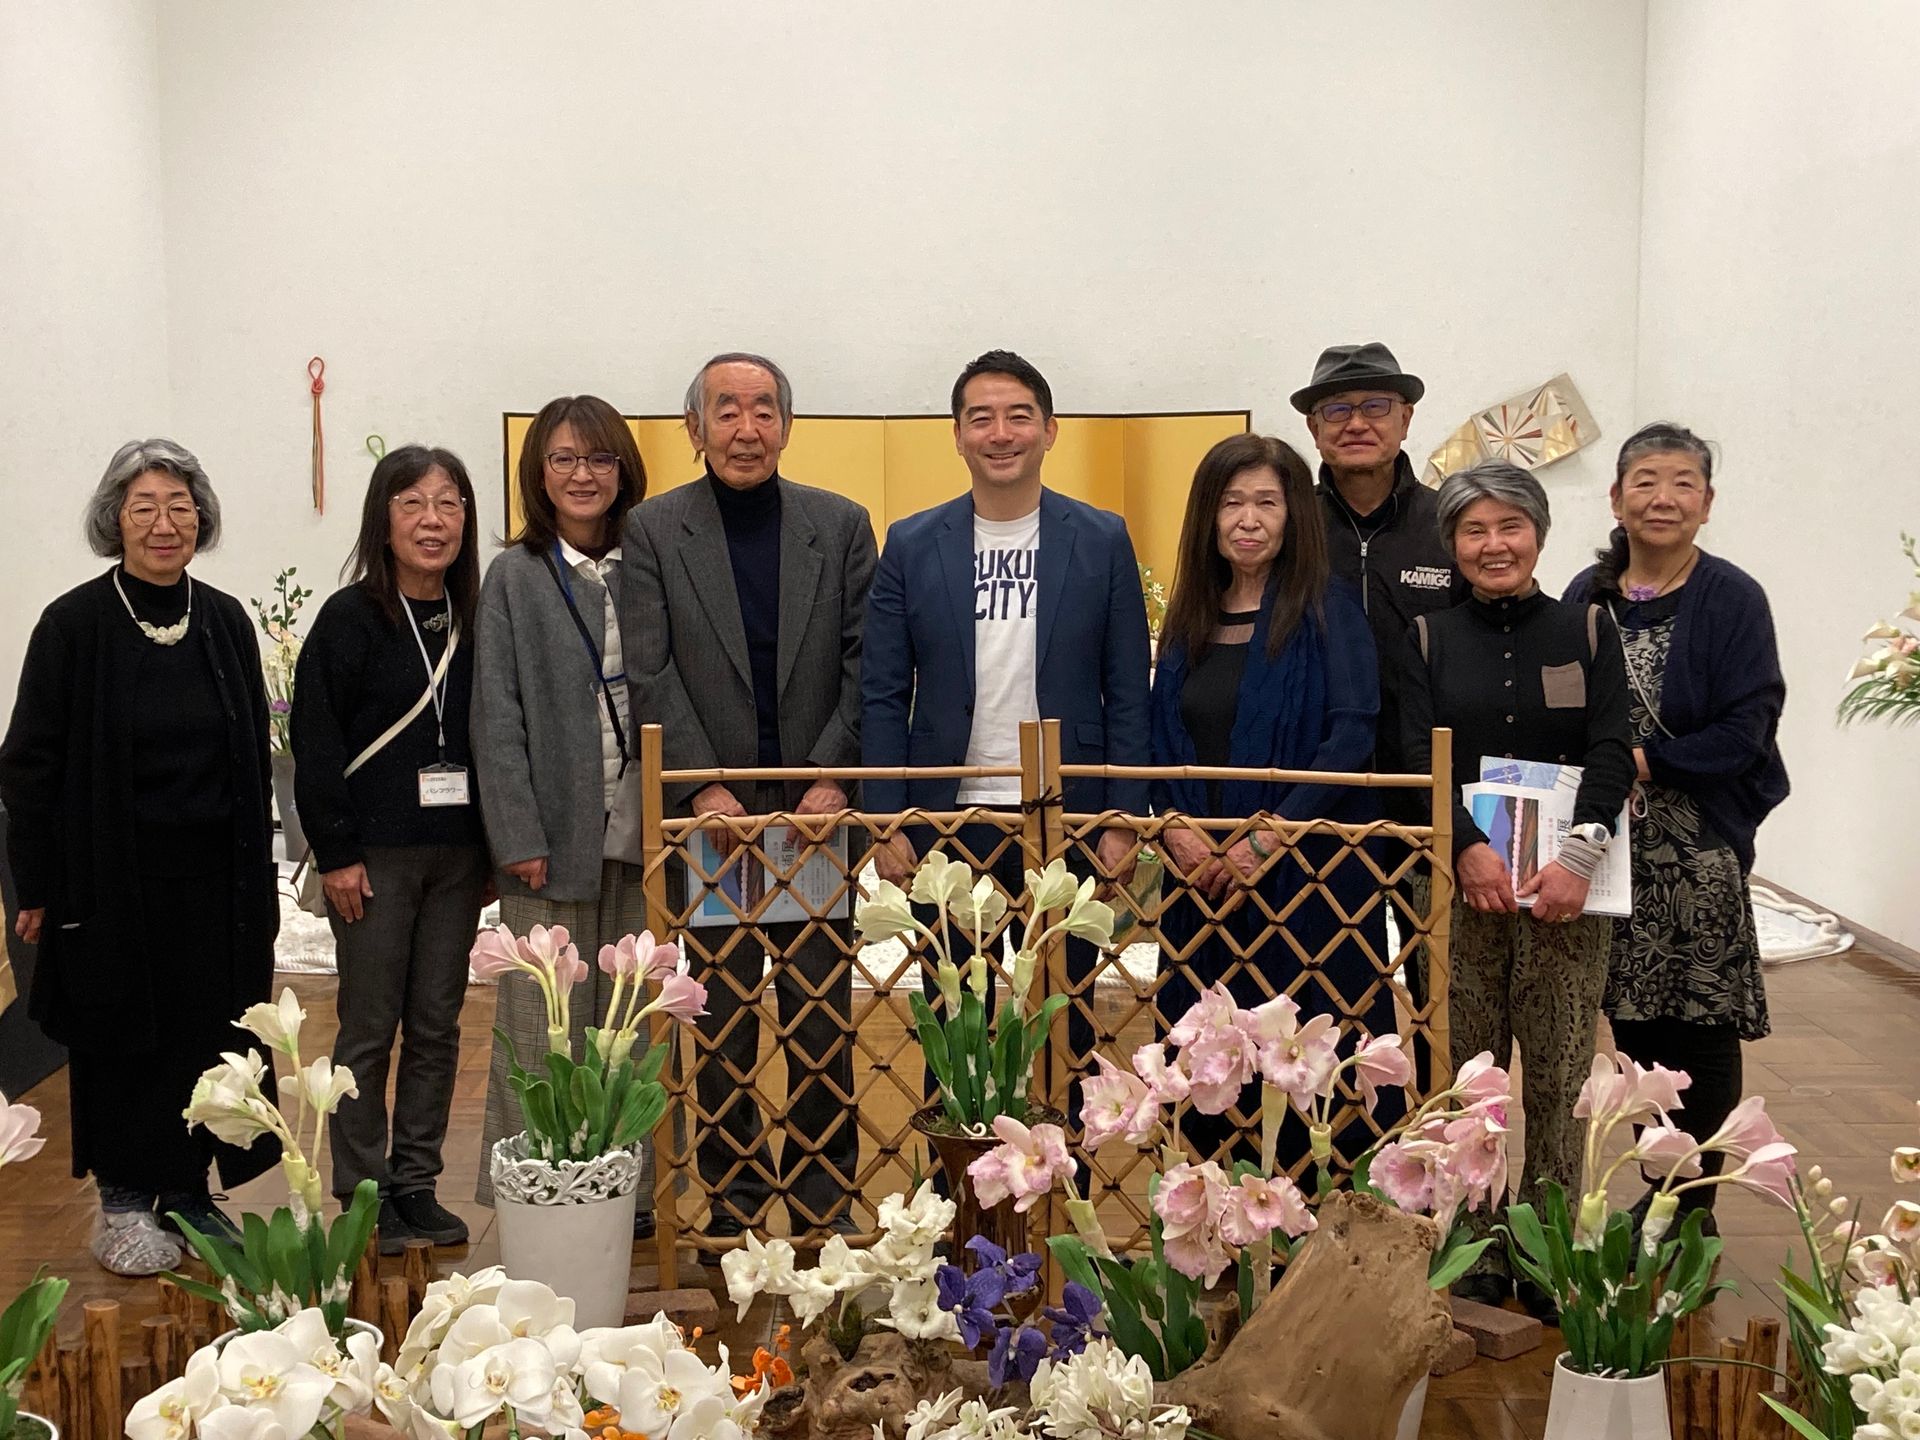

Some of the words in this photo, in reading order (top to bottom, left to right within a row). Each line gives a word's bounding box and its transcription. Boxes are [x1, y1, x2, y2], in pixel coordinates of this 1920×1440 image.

[972, 549, 1039, 581] UKU
[1400, 569, 1452, 588] KAMIGO
[974, 580, 1036, 620] CITY
